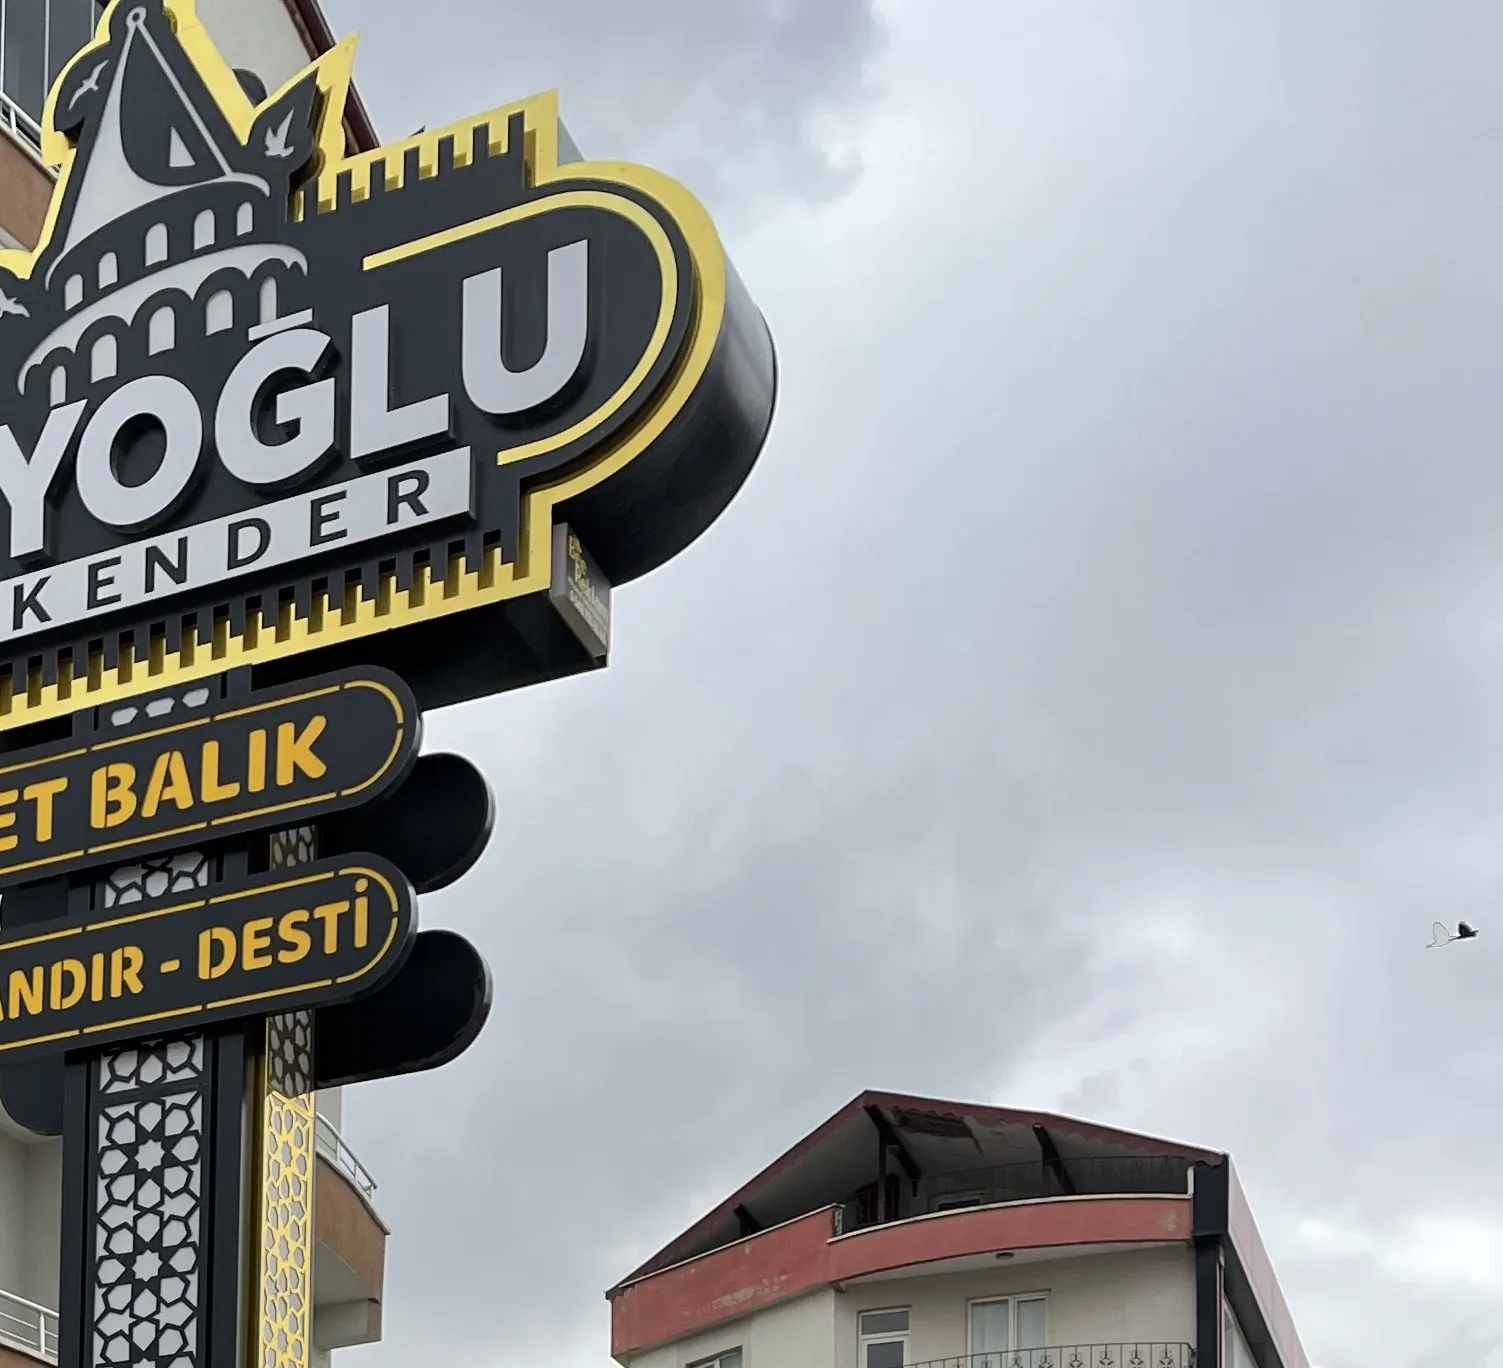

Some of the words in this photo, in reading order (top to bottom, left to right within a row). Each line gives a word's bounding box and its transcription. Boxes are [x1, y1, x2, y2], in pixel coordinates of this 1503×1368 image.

[90, 714, 329, 830] BALIK
[160, 959, 181, 975] -
[198, 876, 370, 981] DESTİ
